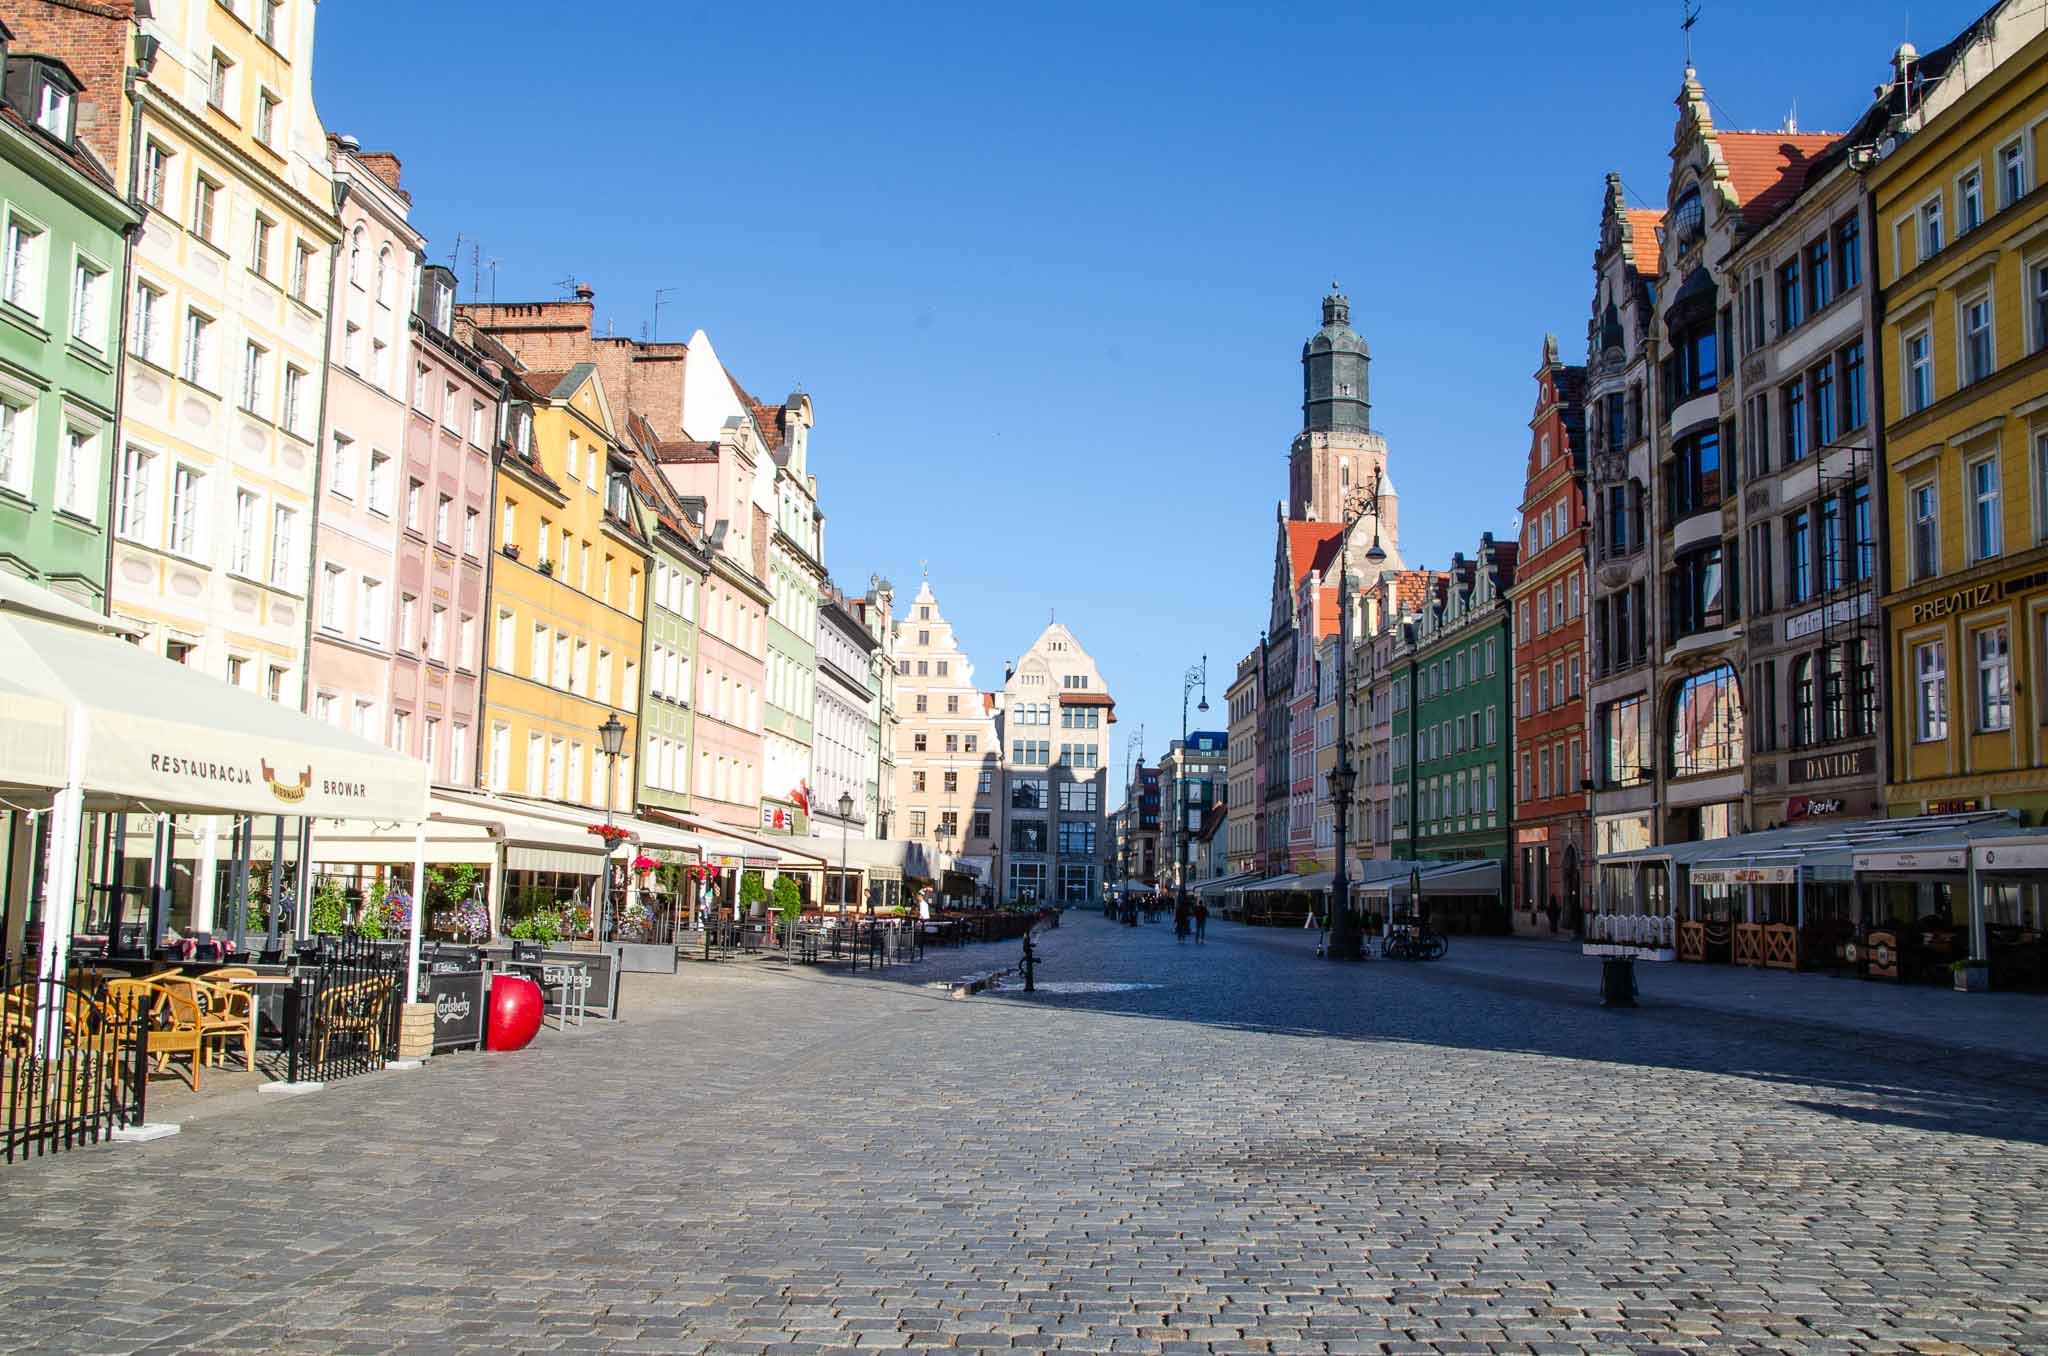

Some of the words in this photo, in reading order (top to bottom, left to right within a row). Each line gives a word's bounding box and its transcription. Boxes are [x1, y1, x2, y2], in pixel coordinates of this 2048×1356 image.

[151, 754, 251, 784] RESTAURACJA
[323, 780, 366, 798] BROWAR
[1807, 752, 1860, 780] DAVIDE
[543, 965, 592, 988] arlberg
[436, 992, 470, 1023] Carlsberg
